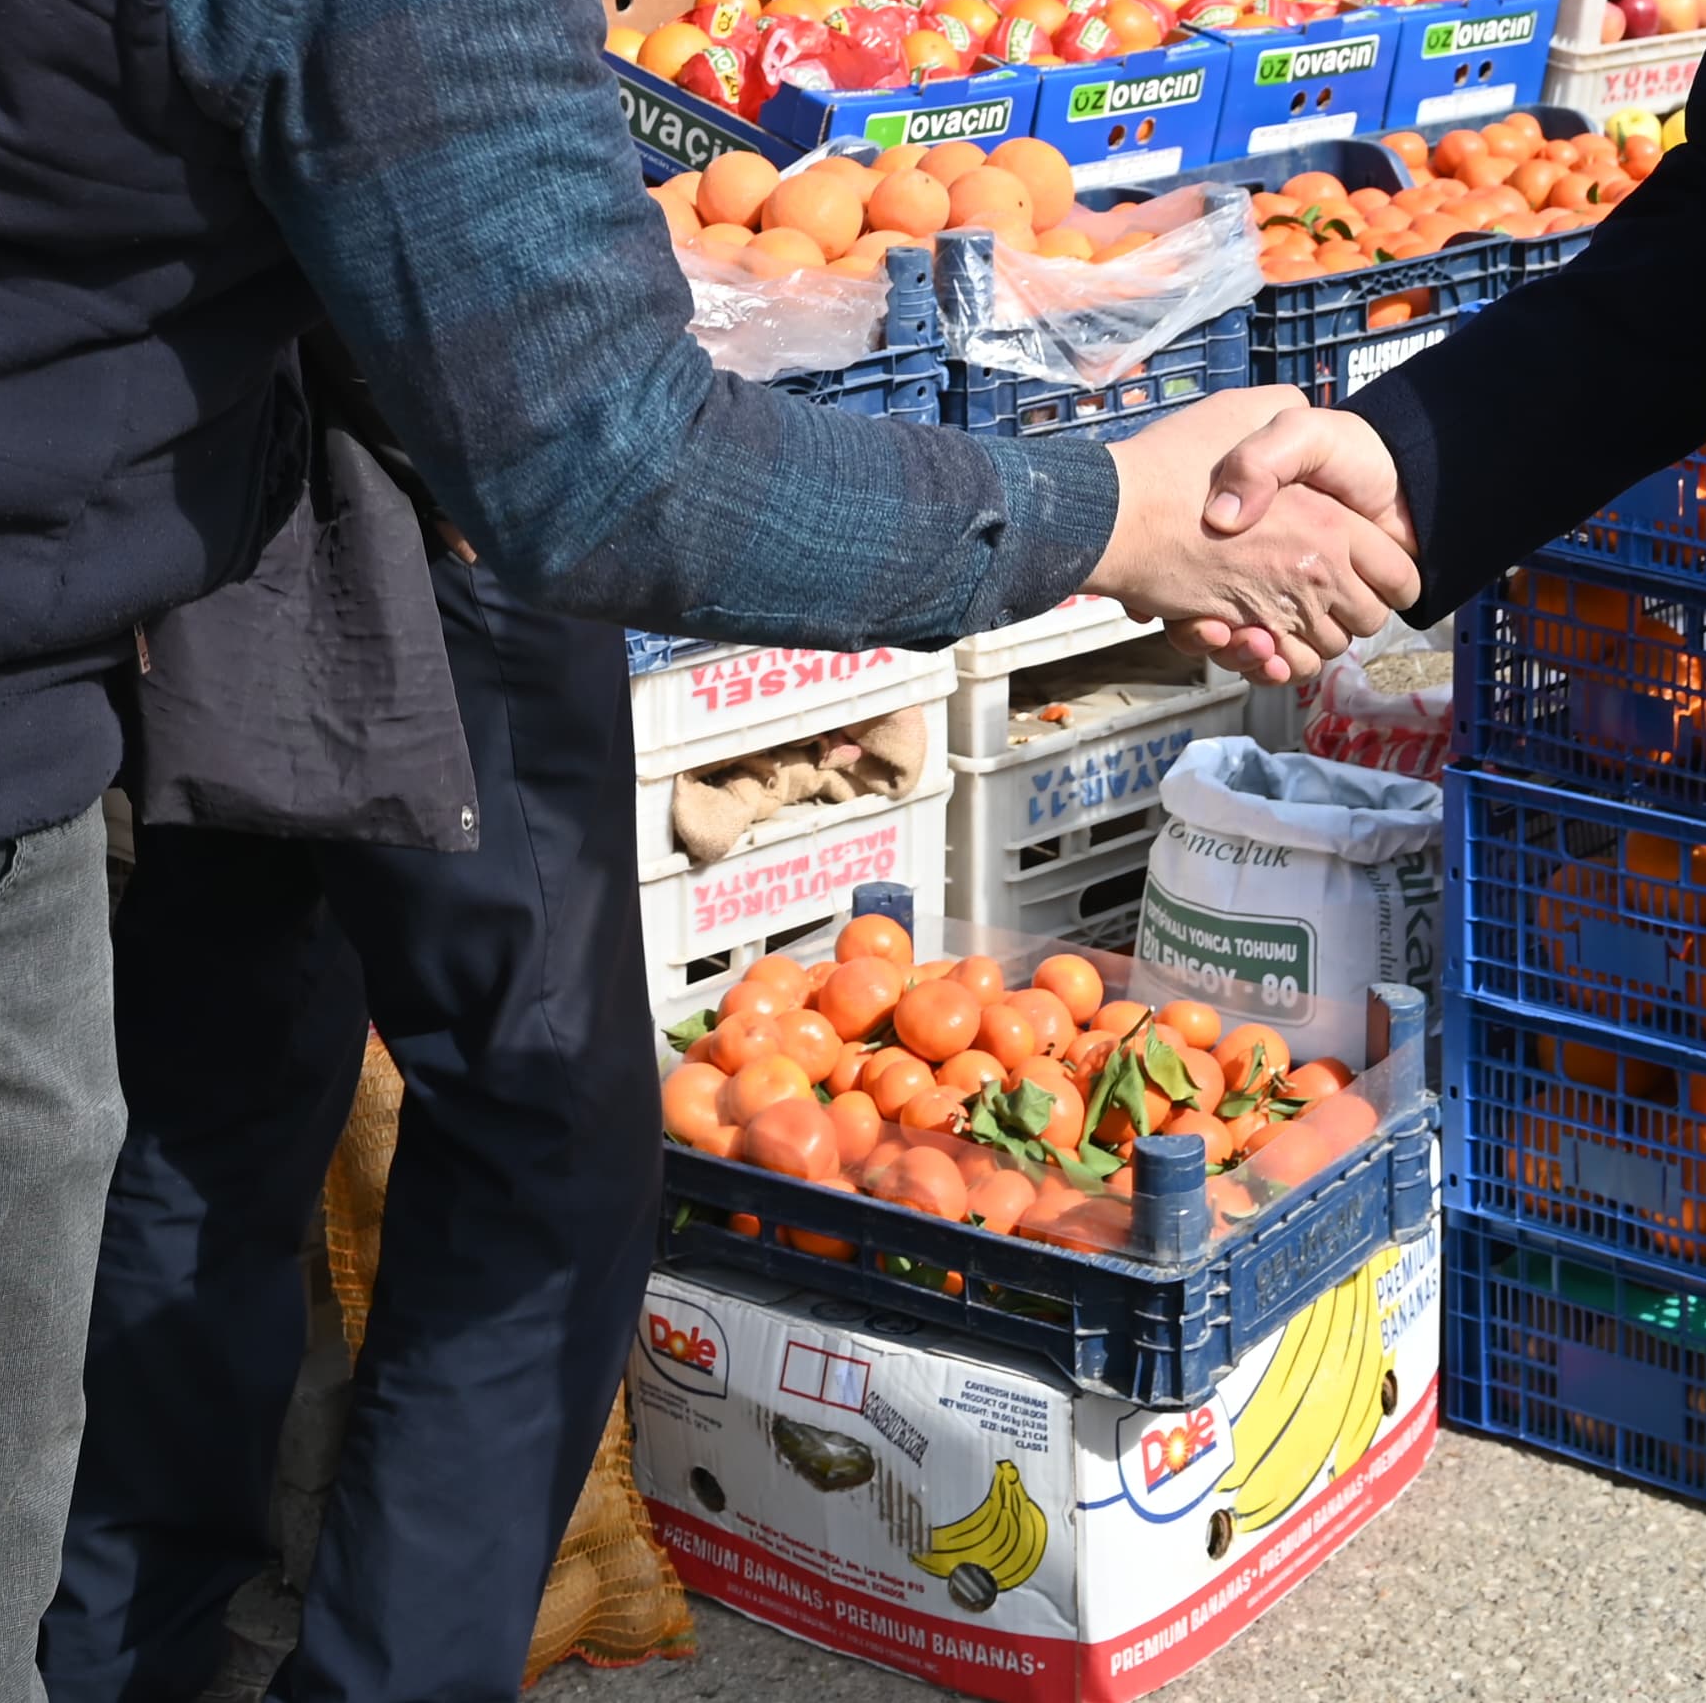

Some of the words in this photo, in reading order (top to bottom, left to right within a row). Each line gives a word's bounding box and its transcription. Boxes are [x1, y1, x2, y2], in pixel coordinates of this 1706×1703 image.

[617, 85, 738, 166] ovaçi
[908, 103, 1006, 142] ovaçin
[1031, 728, 1193, 793] MALATYA
[693, 854, 811, 906] MALATYA
[693, 848, 896, 934] ÖZPÜTÜRGE
[1188, 926, 1233, 956] YONCA
[1234, 937, 1298, 963] TOHUMU
[1261, 971, 1299, 1008] 80
[1376, 1228, 1436, 1310] PREMIUM
[1380, 1267, 1438, 1351] BANANAS
[648, 1312, 717, 1370] Dole
[938, 1396, 953, 1409] NET
[960, 1390, 997, 1409] PRODUCT
[998, 1399, 1009, 1411] OF
[963, 1379, 1010, 1400] CAVENDISH
[1010, 1392, 1049, 1410] BANANAS
[979, 1418, 1000, 1433] SIZE:
[1014, 1438, 1043, 1453] CLASS
[1139, 1405, 1216, 1489] Dole
[662, 1526, 740, 1575] PREMIUM
[743, 1560, 825, 1613] BANANAS
[835, 1600, 927, 1651] PREMIUM
[931, 1632, 1036, 1678] BANANAS
[1109, 1614, 1189, 1679] PREMIUM
[1190, 1567, 1252, 1634] BANANAS
[1258, 1518, 1314, 1579] PREMIUM
[1312, 1473, 1364, 1534] BANANAS
